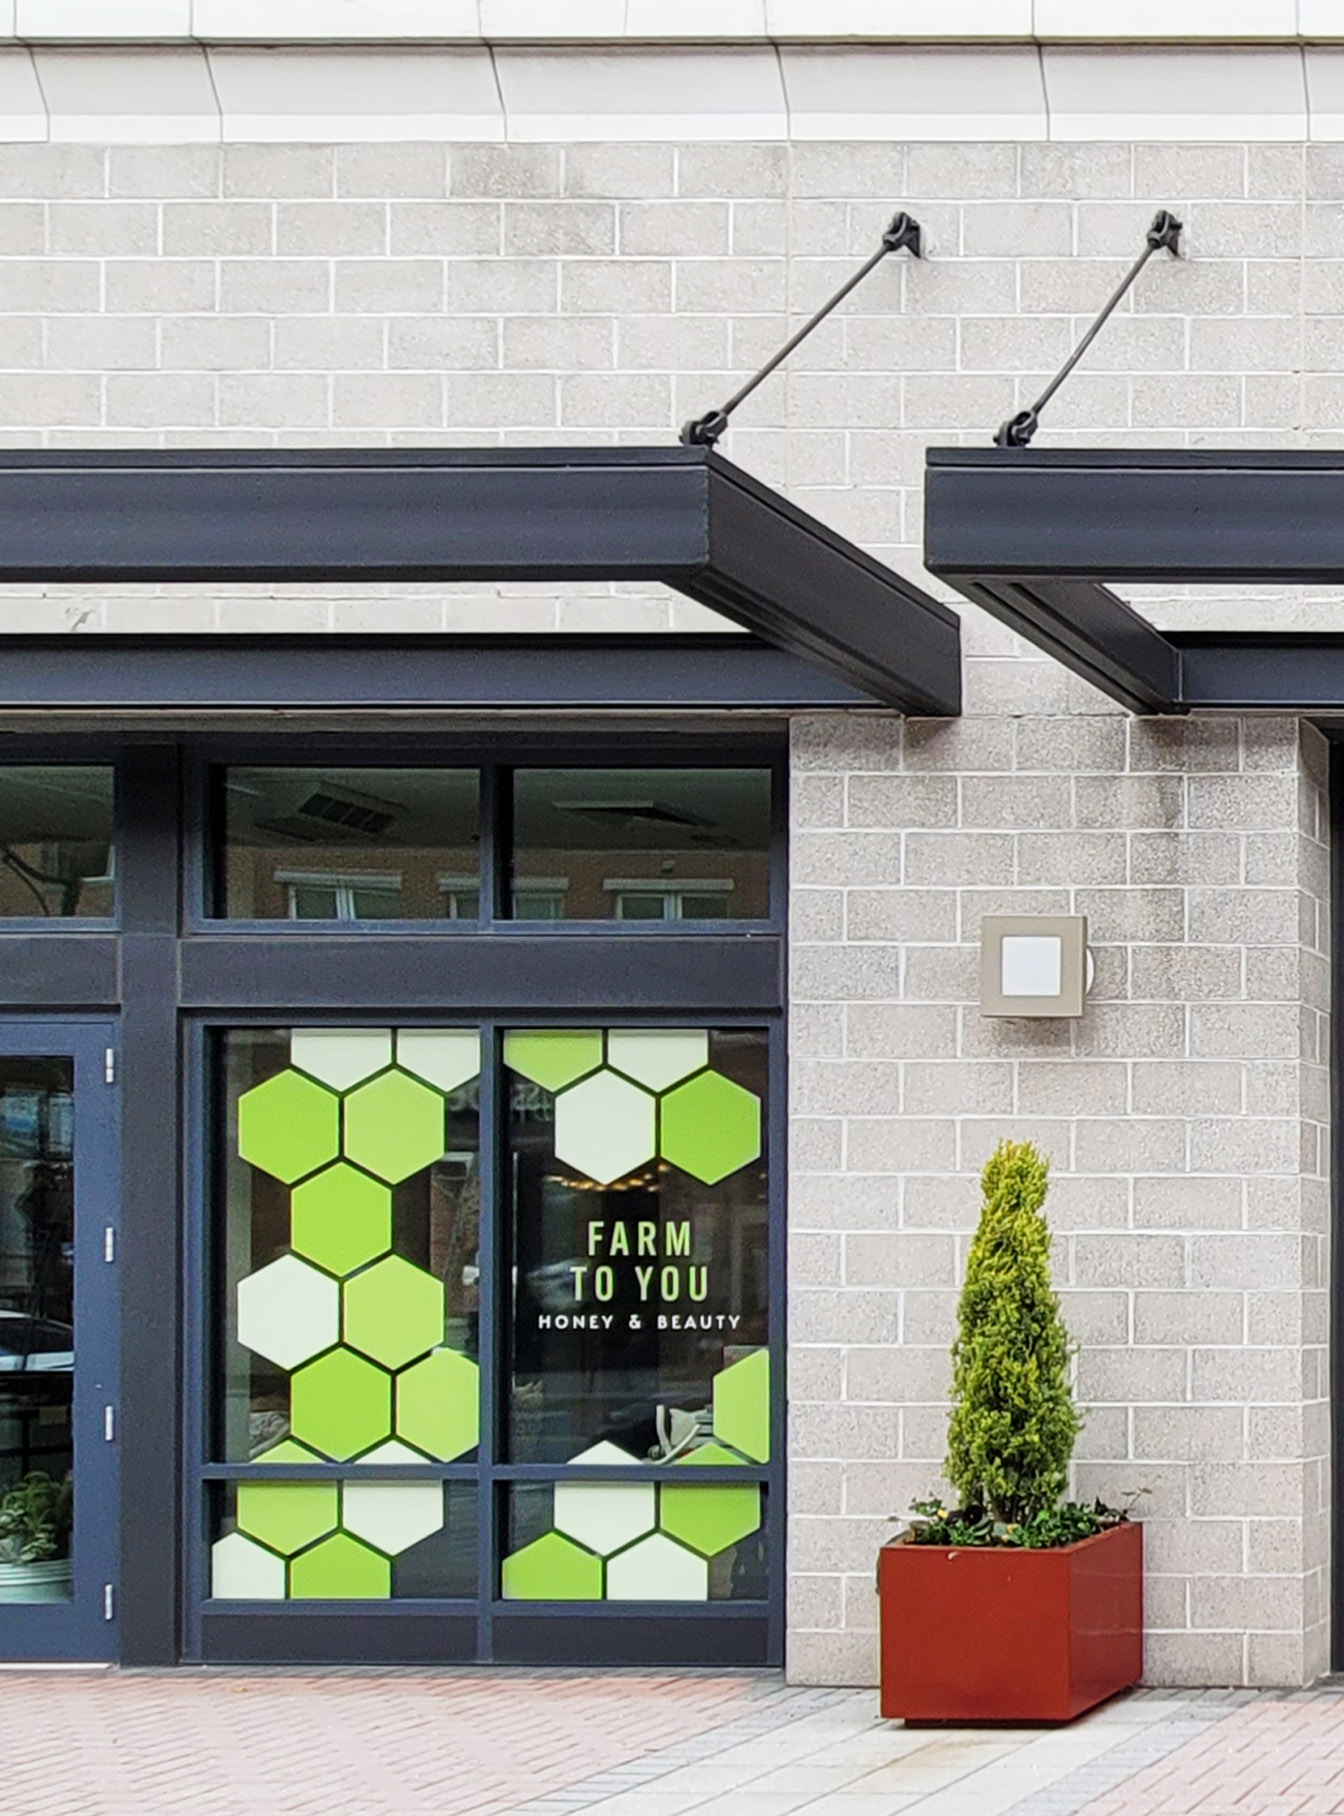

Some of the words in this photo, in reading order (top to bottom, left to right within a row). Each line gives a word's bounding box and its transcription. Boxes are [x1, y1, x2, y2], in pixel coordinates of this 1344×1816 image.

[587, 1221, 691, 1257] FARM
[569, 1265, 615, 1302] TO
[634, 1265, 709, 1302] YOU
[537, 1314, 614, 1330] HONEY
[628, 1314, 642, 1330] &
[656, 1314, 741, 1330] BEAUTY
